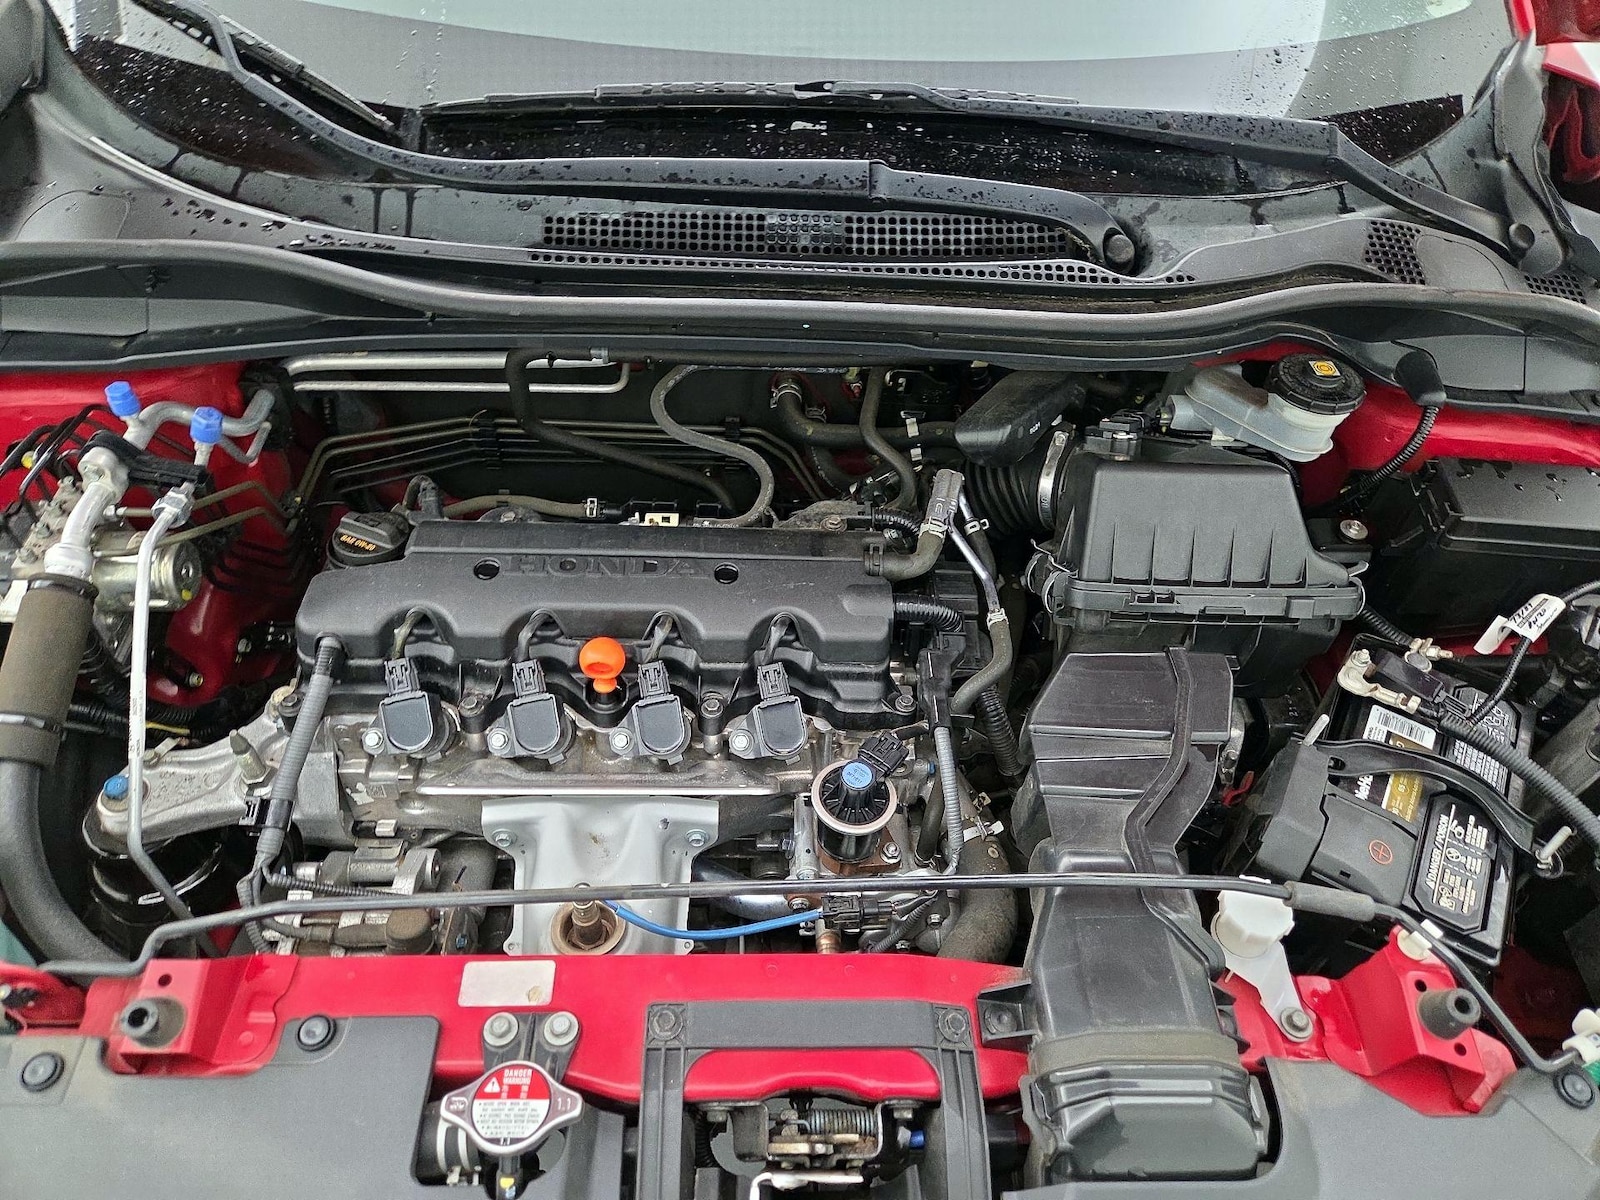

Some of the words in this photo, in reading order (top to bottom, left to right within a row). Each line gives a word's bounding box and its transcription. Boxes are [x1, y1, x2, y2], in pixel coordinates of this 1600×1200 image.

[503, 555, 710, 579] HONDA
[1427, 847, 1442, 882] DANGER
[1435, 813, 1450, 842] POISON
[503, 1069, 533, 1078] DANGER
[556, 1097, 572, 1111] 1.1
